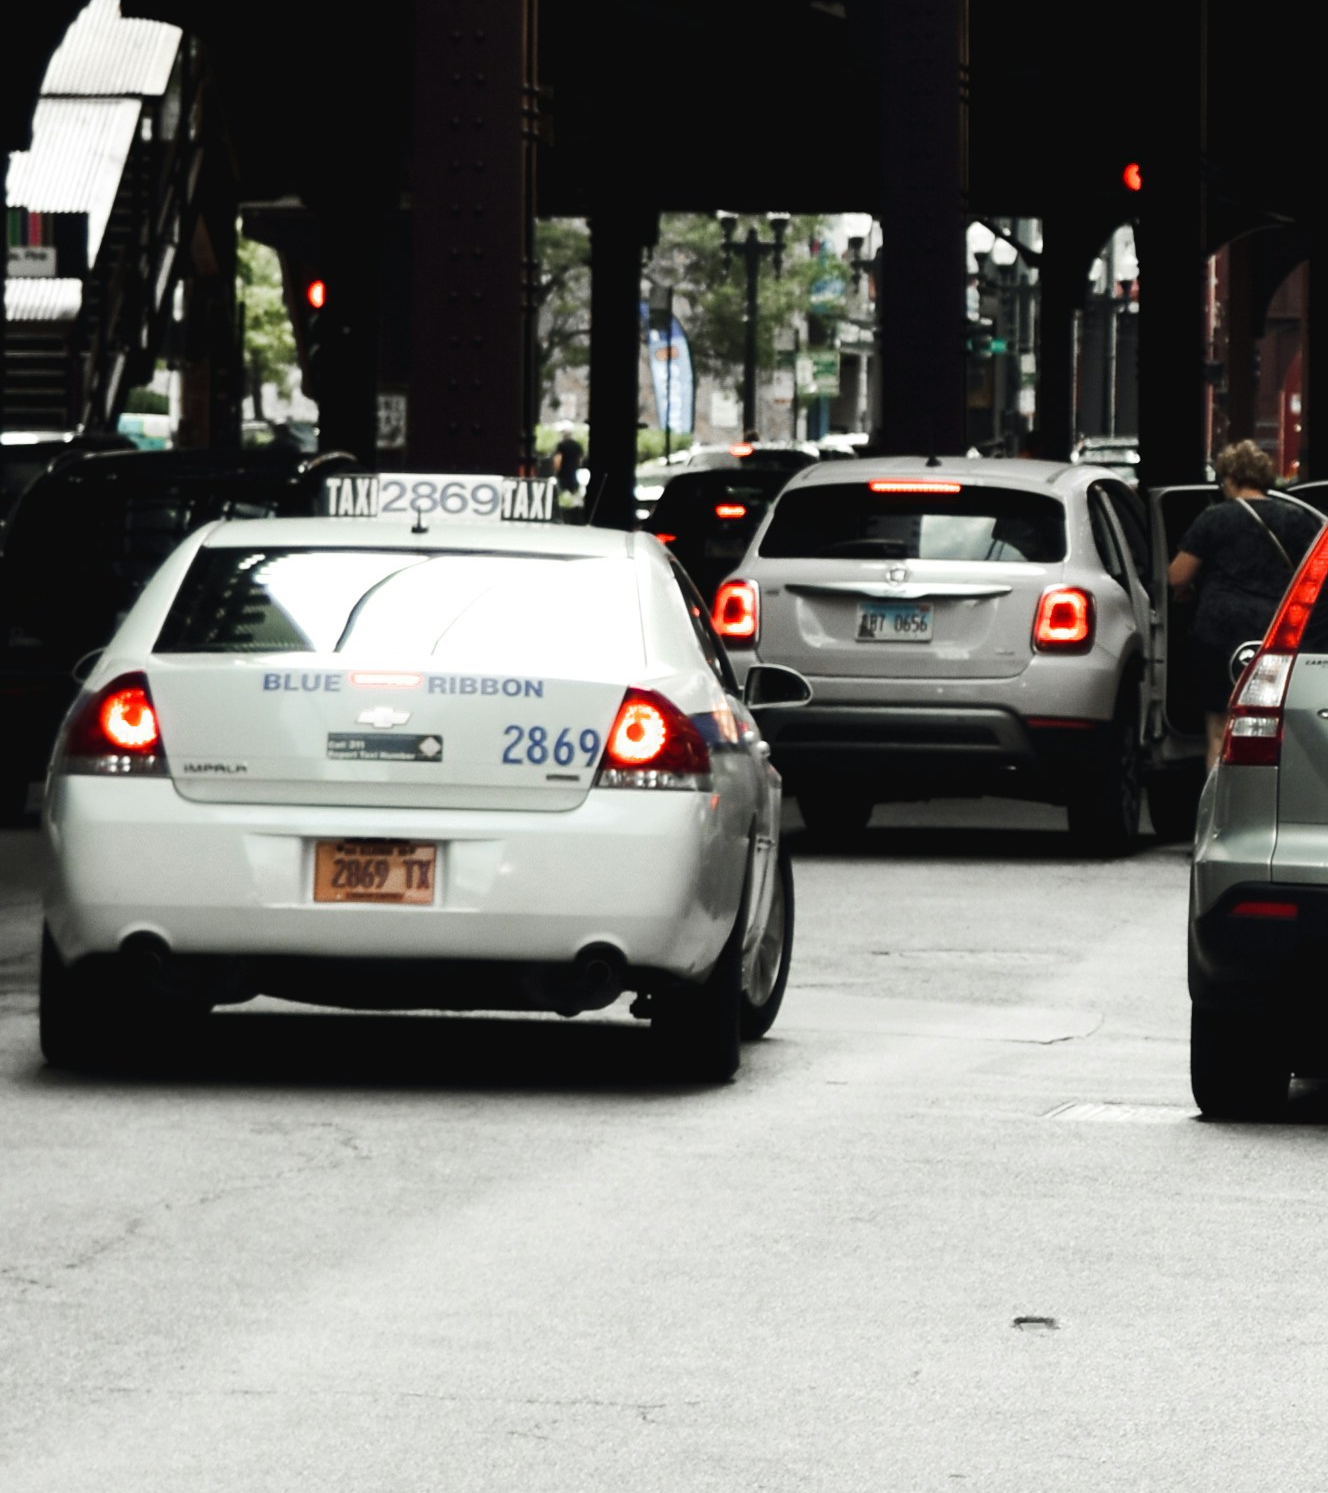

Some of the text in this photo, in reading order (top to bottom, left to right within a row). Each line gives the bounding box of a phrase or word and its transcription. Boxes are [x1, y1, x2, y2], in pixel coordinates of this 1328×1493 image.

[326, 477, 556, 521] TAXI 2869 TAXI
[262, 673, 545, 698] BLUE RIBBON
[502, 724, 600, 769] 2869
[331, 857, 433, 890] 2869 TX
